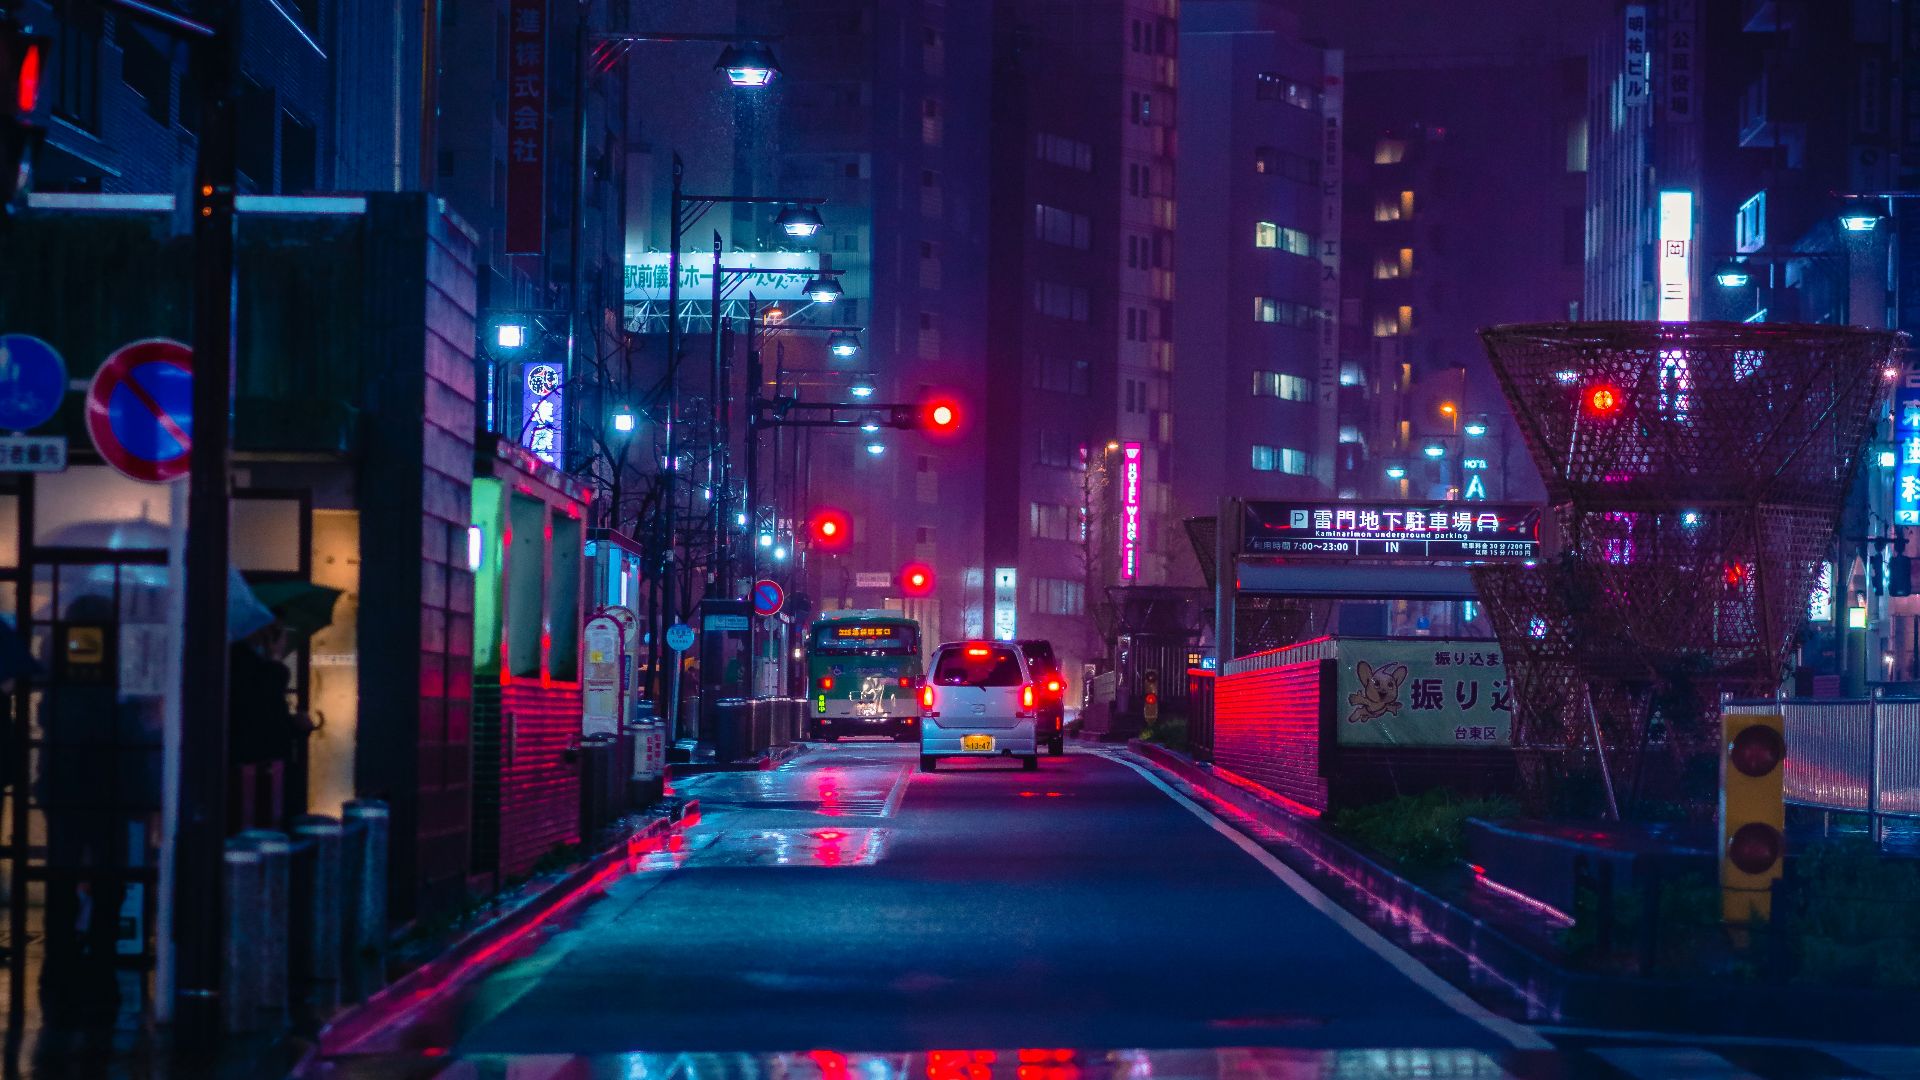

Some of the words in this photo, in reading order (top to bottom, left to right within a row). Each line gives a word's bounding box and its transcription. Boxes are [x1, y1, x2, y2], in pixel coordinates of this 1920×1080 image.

[1127, 462, 1138, 503] HOTEL
[1314, 510, 1472, 531] 雷門地下駐車場
[1375, 531, 1431, 539] underground
[1434, 532, 1468, 540] parking
[1385, 541, 1399, 553] IN
[1454, 726, 1497, 741] 台東区
